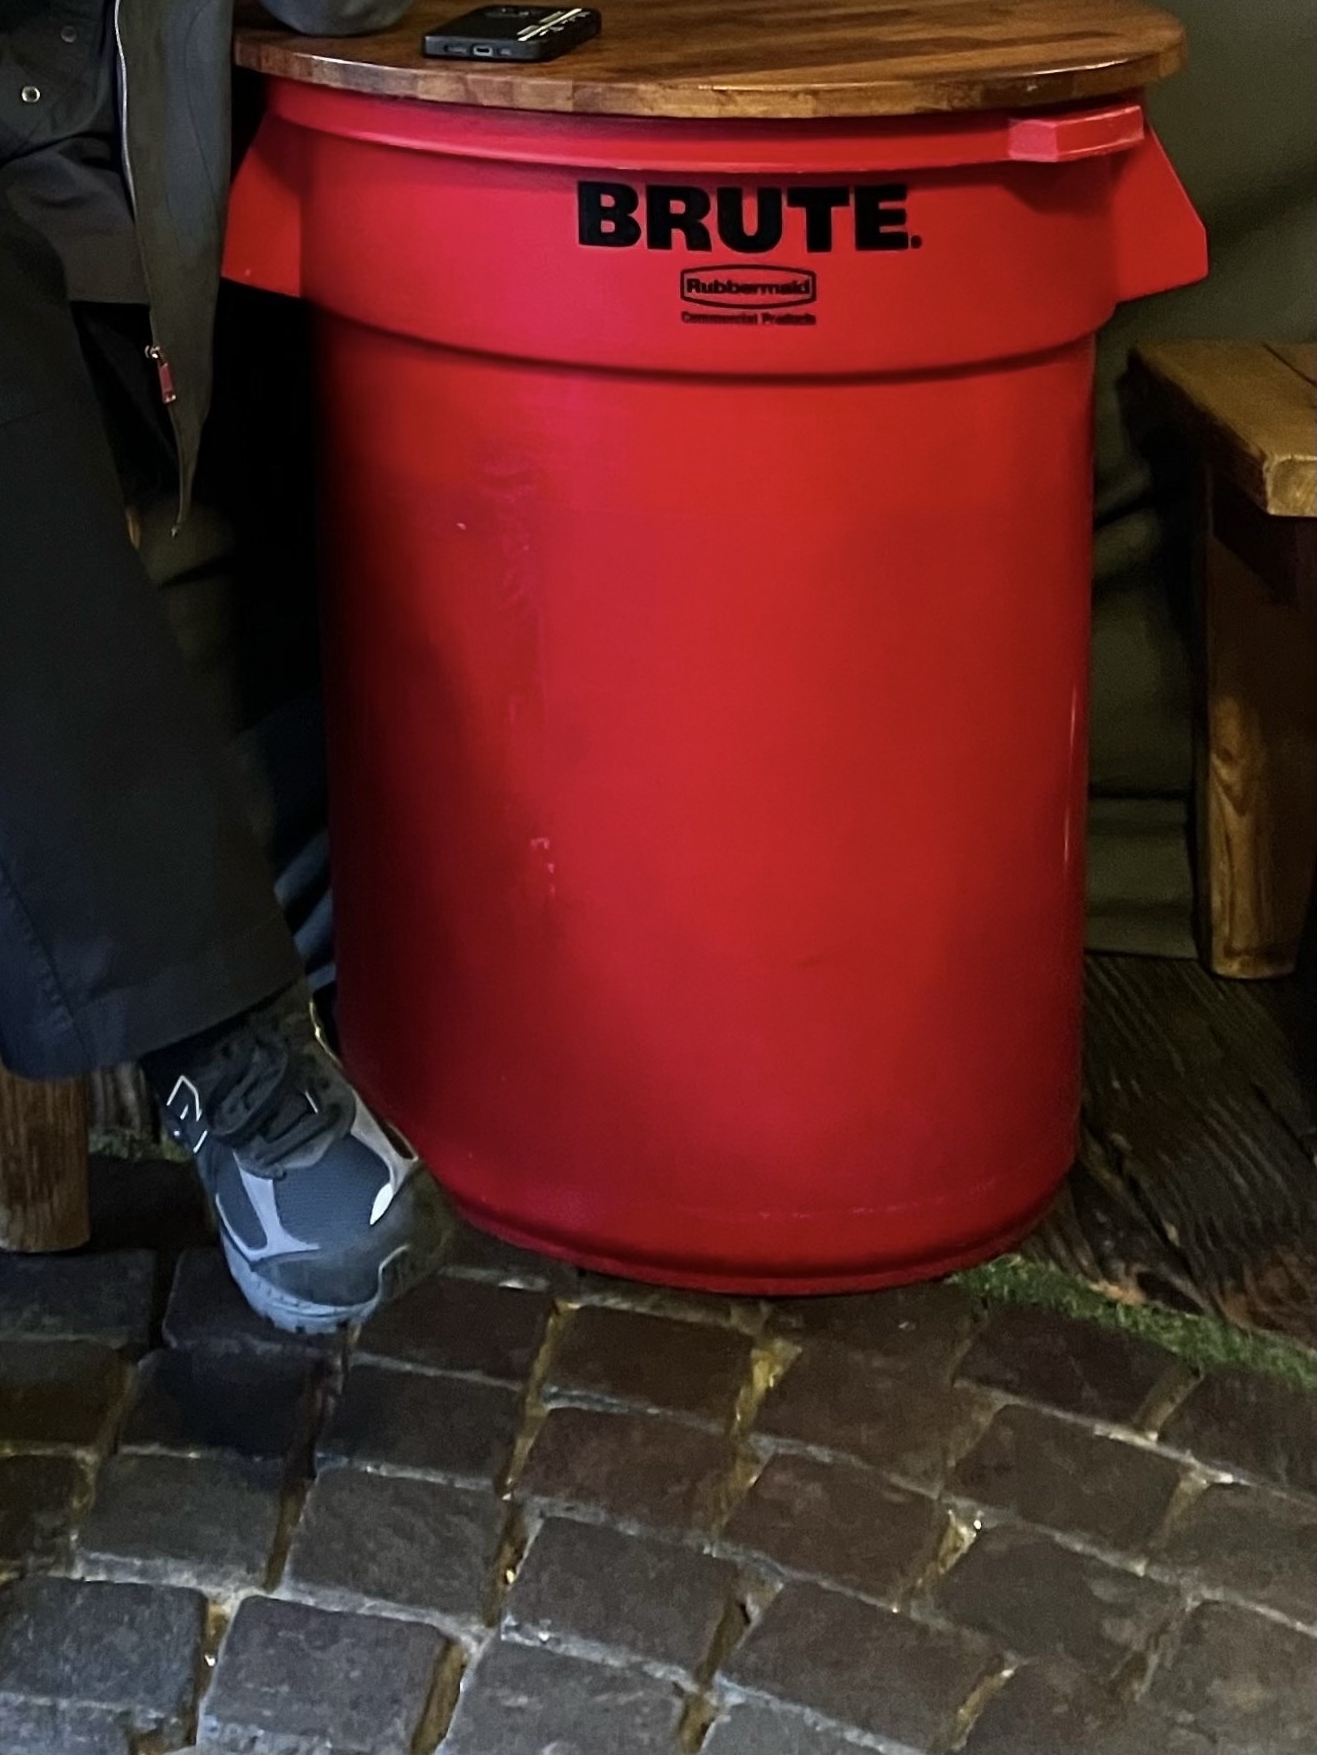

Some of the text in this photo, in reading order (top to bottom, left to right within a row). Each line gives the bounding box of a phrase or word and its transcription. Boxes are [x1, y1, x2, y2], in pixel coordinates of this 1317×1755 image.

[685, 277, 811, 295] Rubbermaid
[681, 310, 817, 326] Commercial Products
